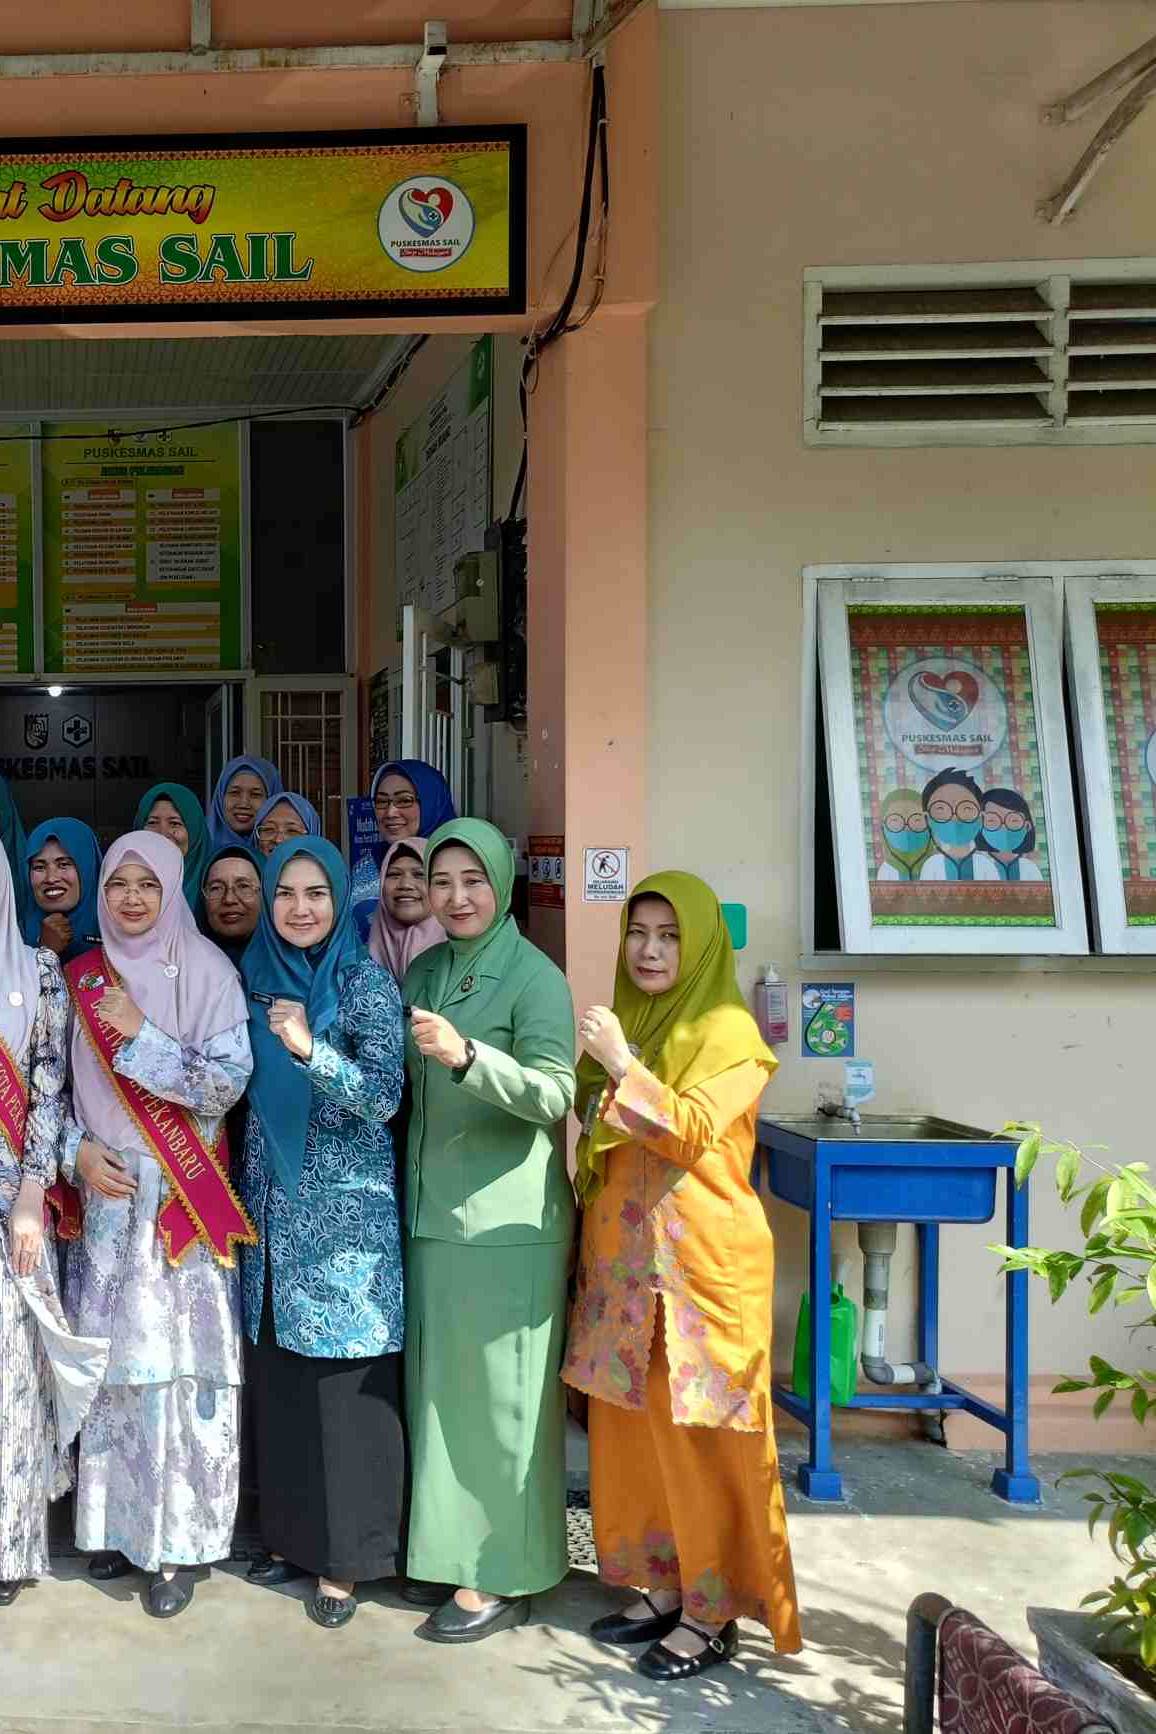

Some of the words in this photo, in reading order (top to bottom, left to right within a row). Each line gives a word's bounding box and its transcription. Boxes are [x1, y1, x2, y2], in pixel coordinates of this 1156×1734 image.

[39, 170, 216, 224] Datang
[159, 232, 314, 285] SAIL
[390, 240, 441, 248] PUSKESMAS
[442, 239, 460, 247] SAIL
[83, 447, 164, 459] PUSKESMAS
[167, 446, 198, 458] SAIL
[901, 734, 967, 743] PUSKESMAS
[970, 733, 995, 743] SAIL
[139, 1092, 206, 1181] PEKANBARU
